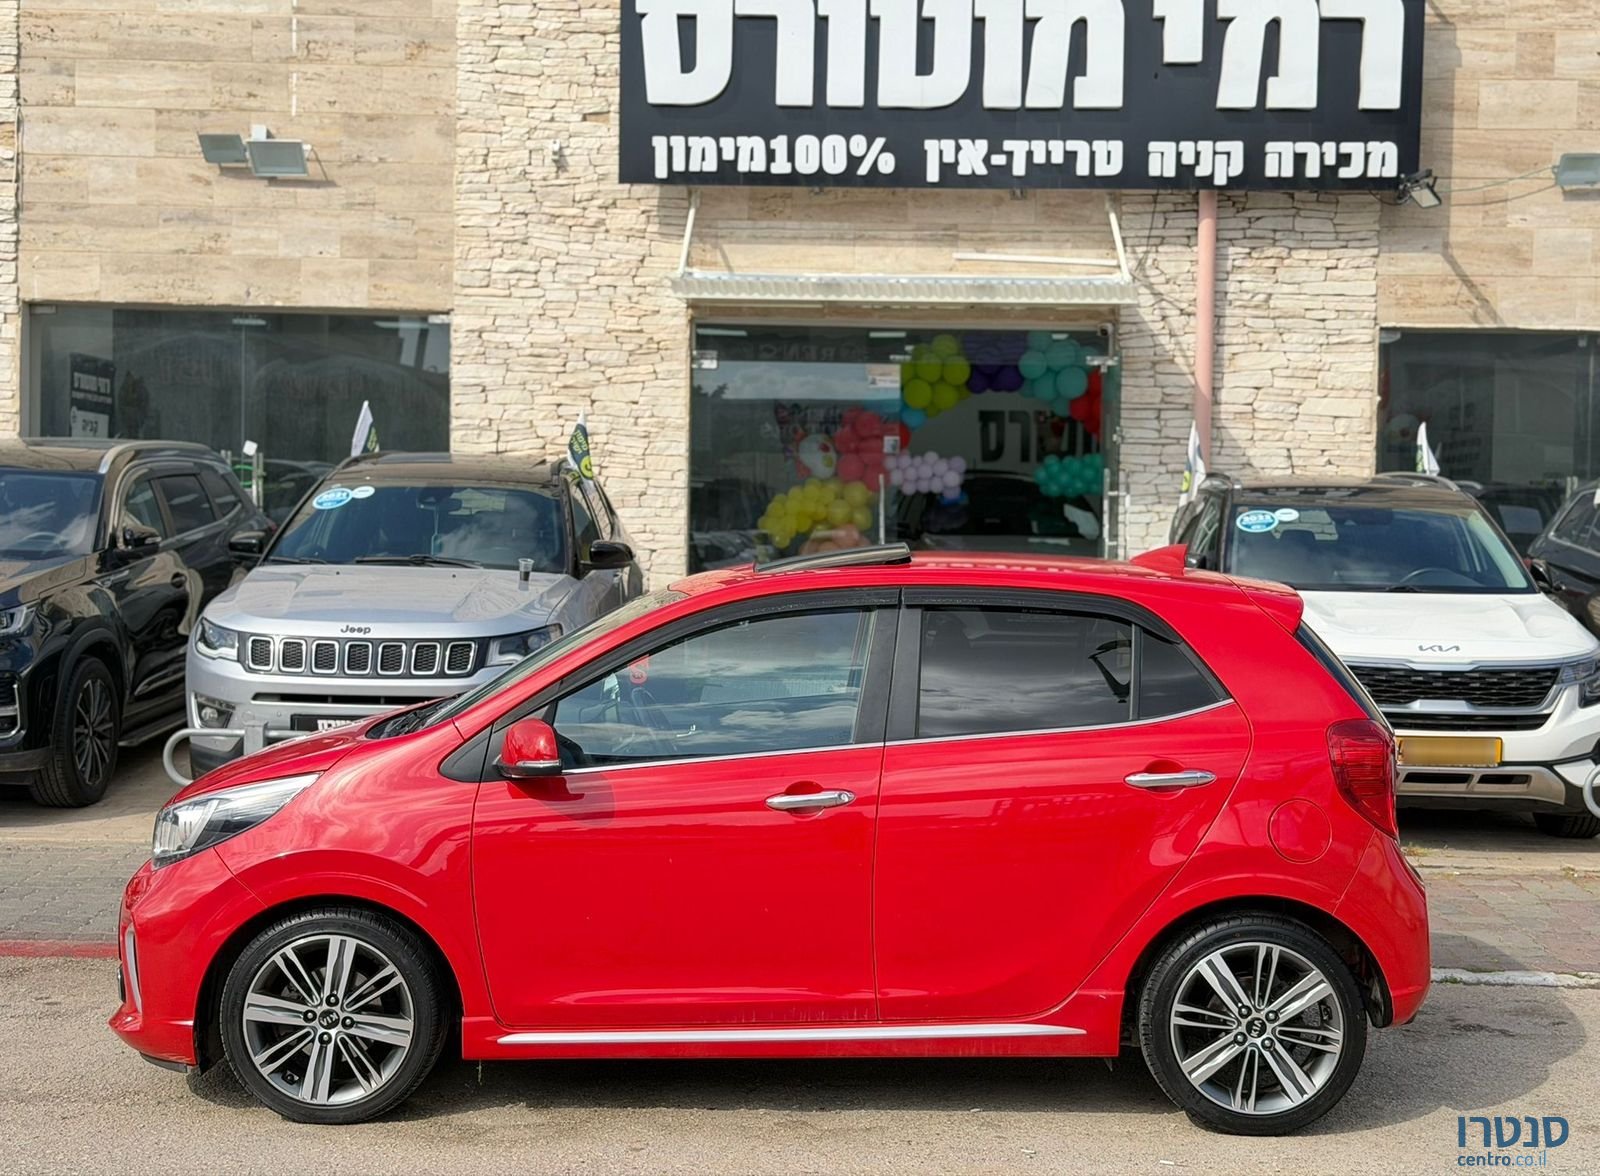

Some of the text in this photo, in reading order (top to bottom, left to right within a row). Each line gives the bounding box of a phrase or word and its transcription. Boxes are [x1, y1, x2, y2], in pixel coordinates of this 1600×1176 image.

[635, 0, 1405, 110] רמי מוטורס
[923, 138, 1124, 183] טרייד-אין
[1147, 140, 1244, 186] קניה
[1264, 141, 1399, 178] מכירה
[340, 624, 372, 635] Jeep
[319, 1012, 339, 1026] KIA
[1250, 1020, 1263, 1037] KIA
